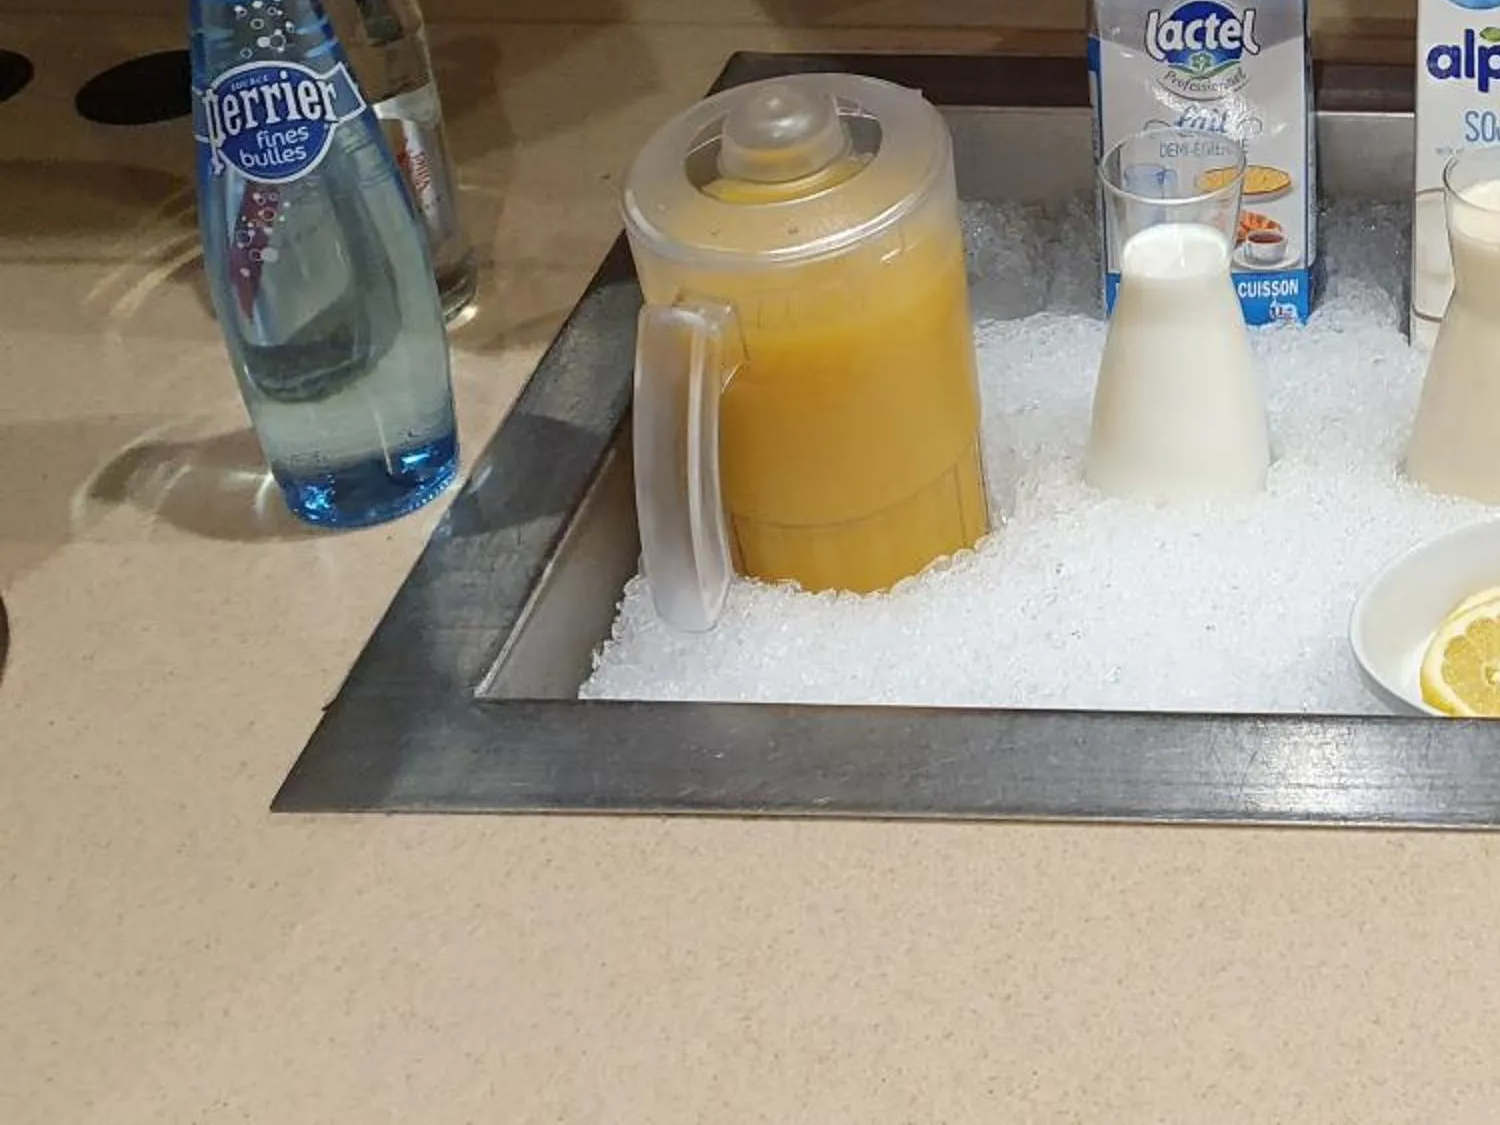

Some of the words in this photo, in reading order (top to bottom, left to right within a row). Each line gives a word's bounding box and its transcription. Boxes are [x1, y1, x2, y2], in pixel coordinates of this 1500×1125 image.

[1145, 9, 1261, 62] lactel
[256, 125, 309, 150] fines
[240, 146, 307, 168] bulles
[1237, 279, 1299, 298] CUISSON
